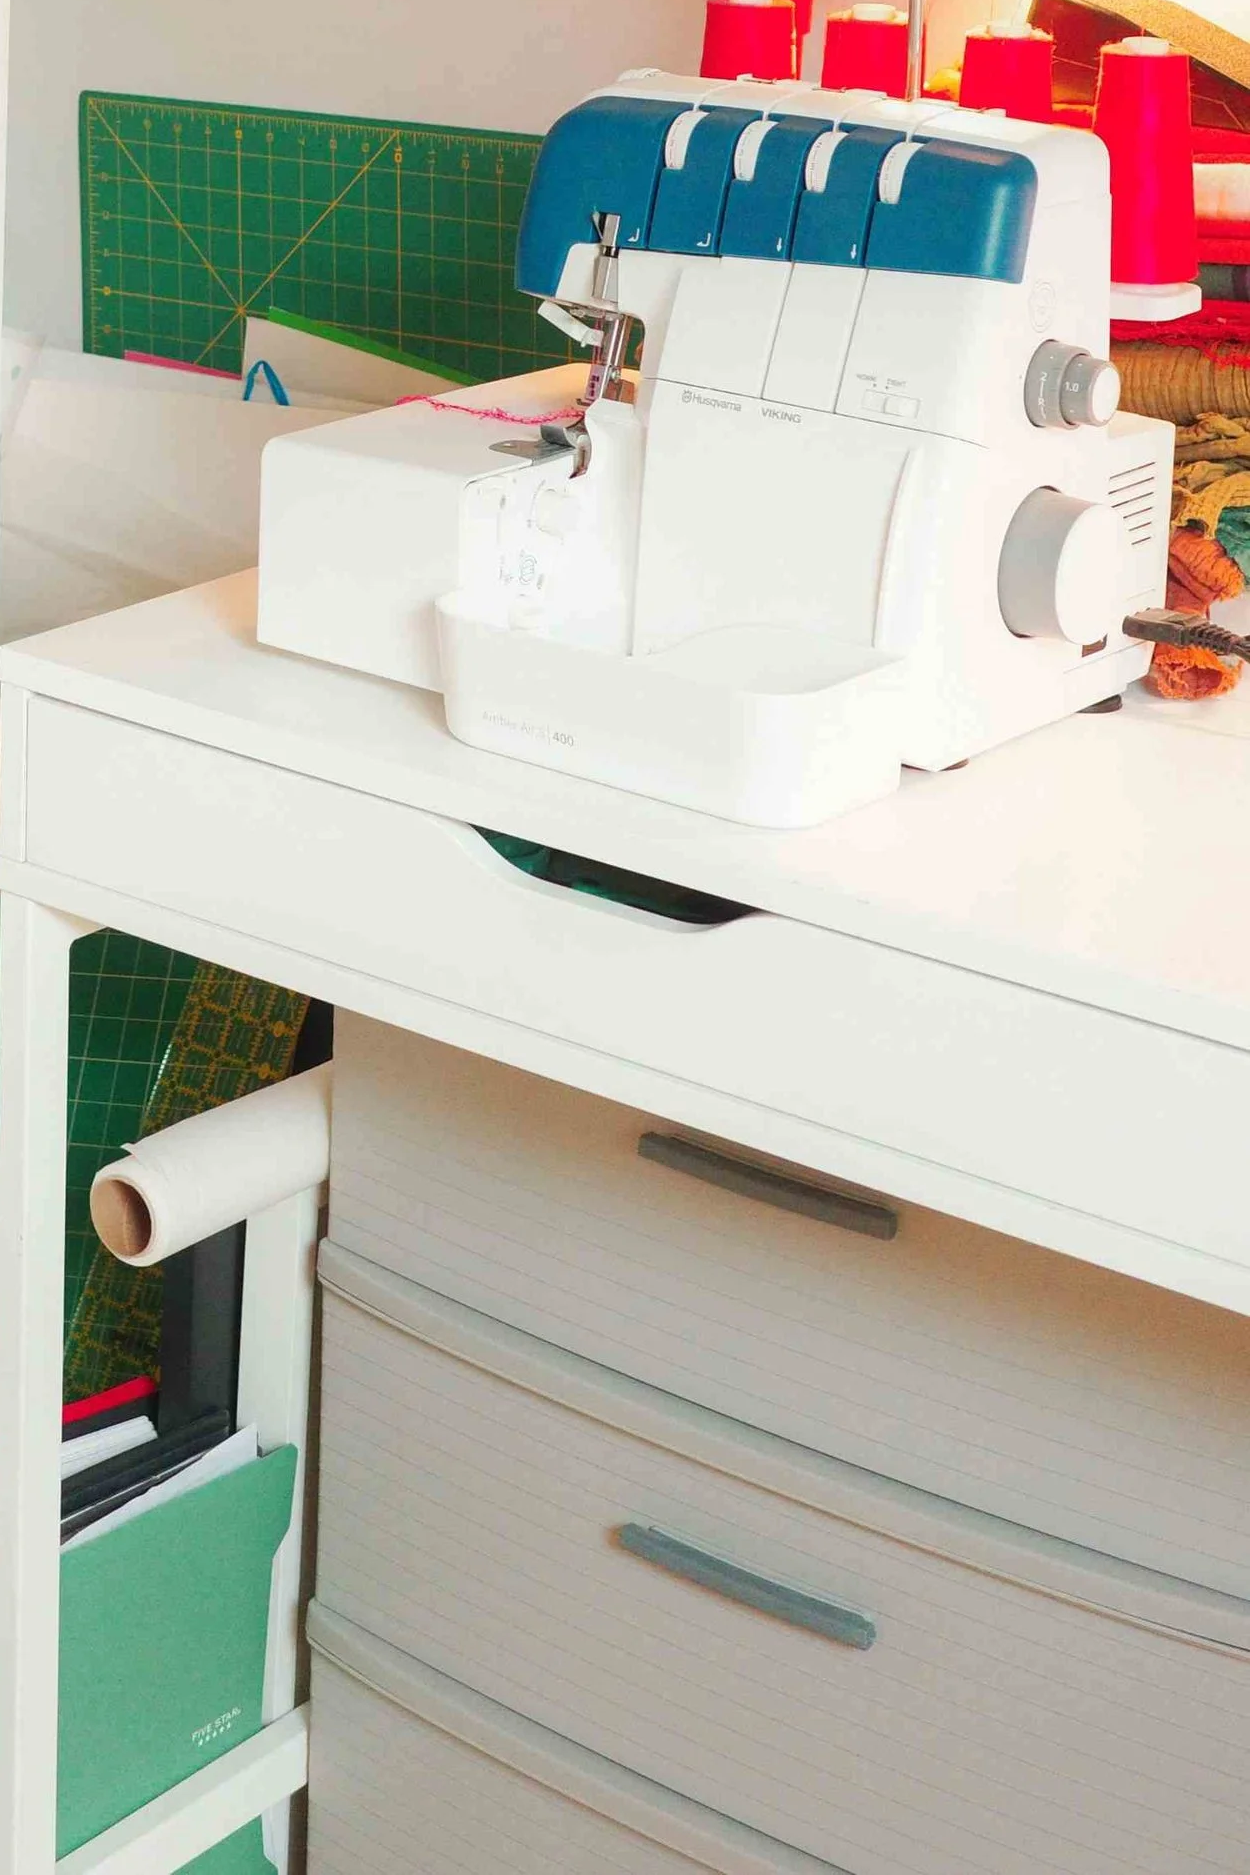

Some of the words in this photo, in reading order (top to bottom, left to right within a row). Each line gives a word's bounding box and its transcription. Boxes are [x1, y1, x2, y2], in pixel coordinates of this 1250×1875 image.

[692, 391, 743, 414] Husqvarna
[760, 406, 803, 425] VIKING
[552, 731, 575, 747] 400
[191, 1723, 211, 1742] FIVE
